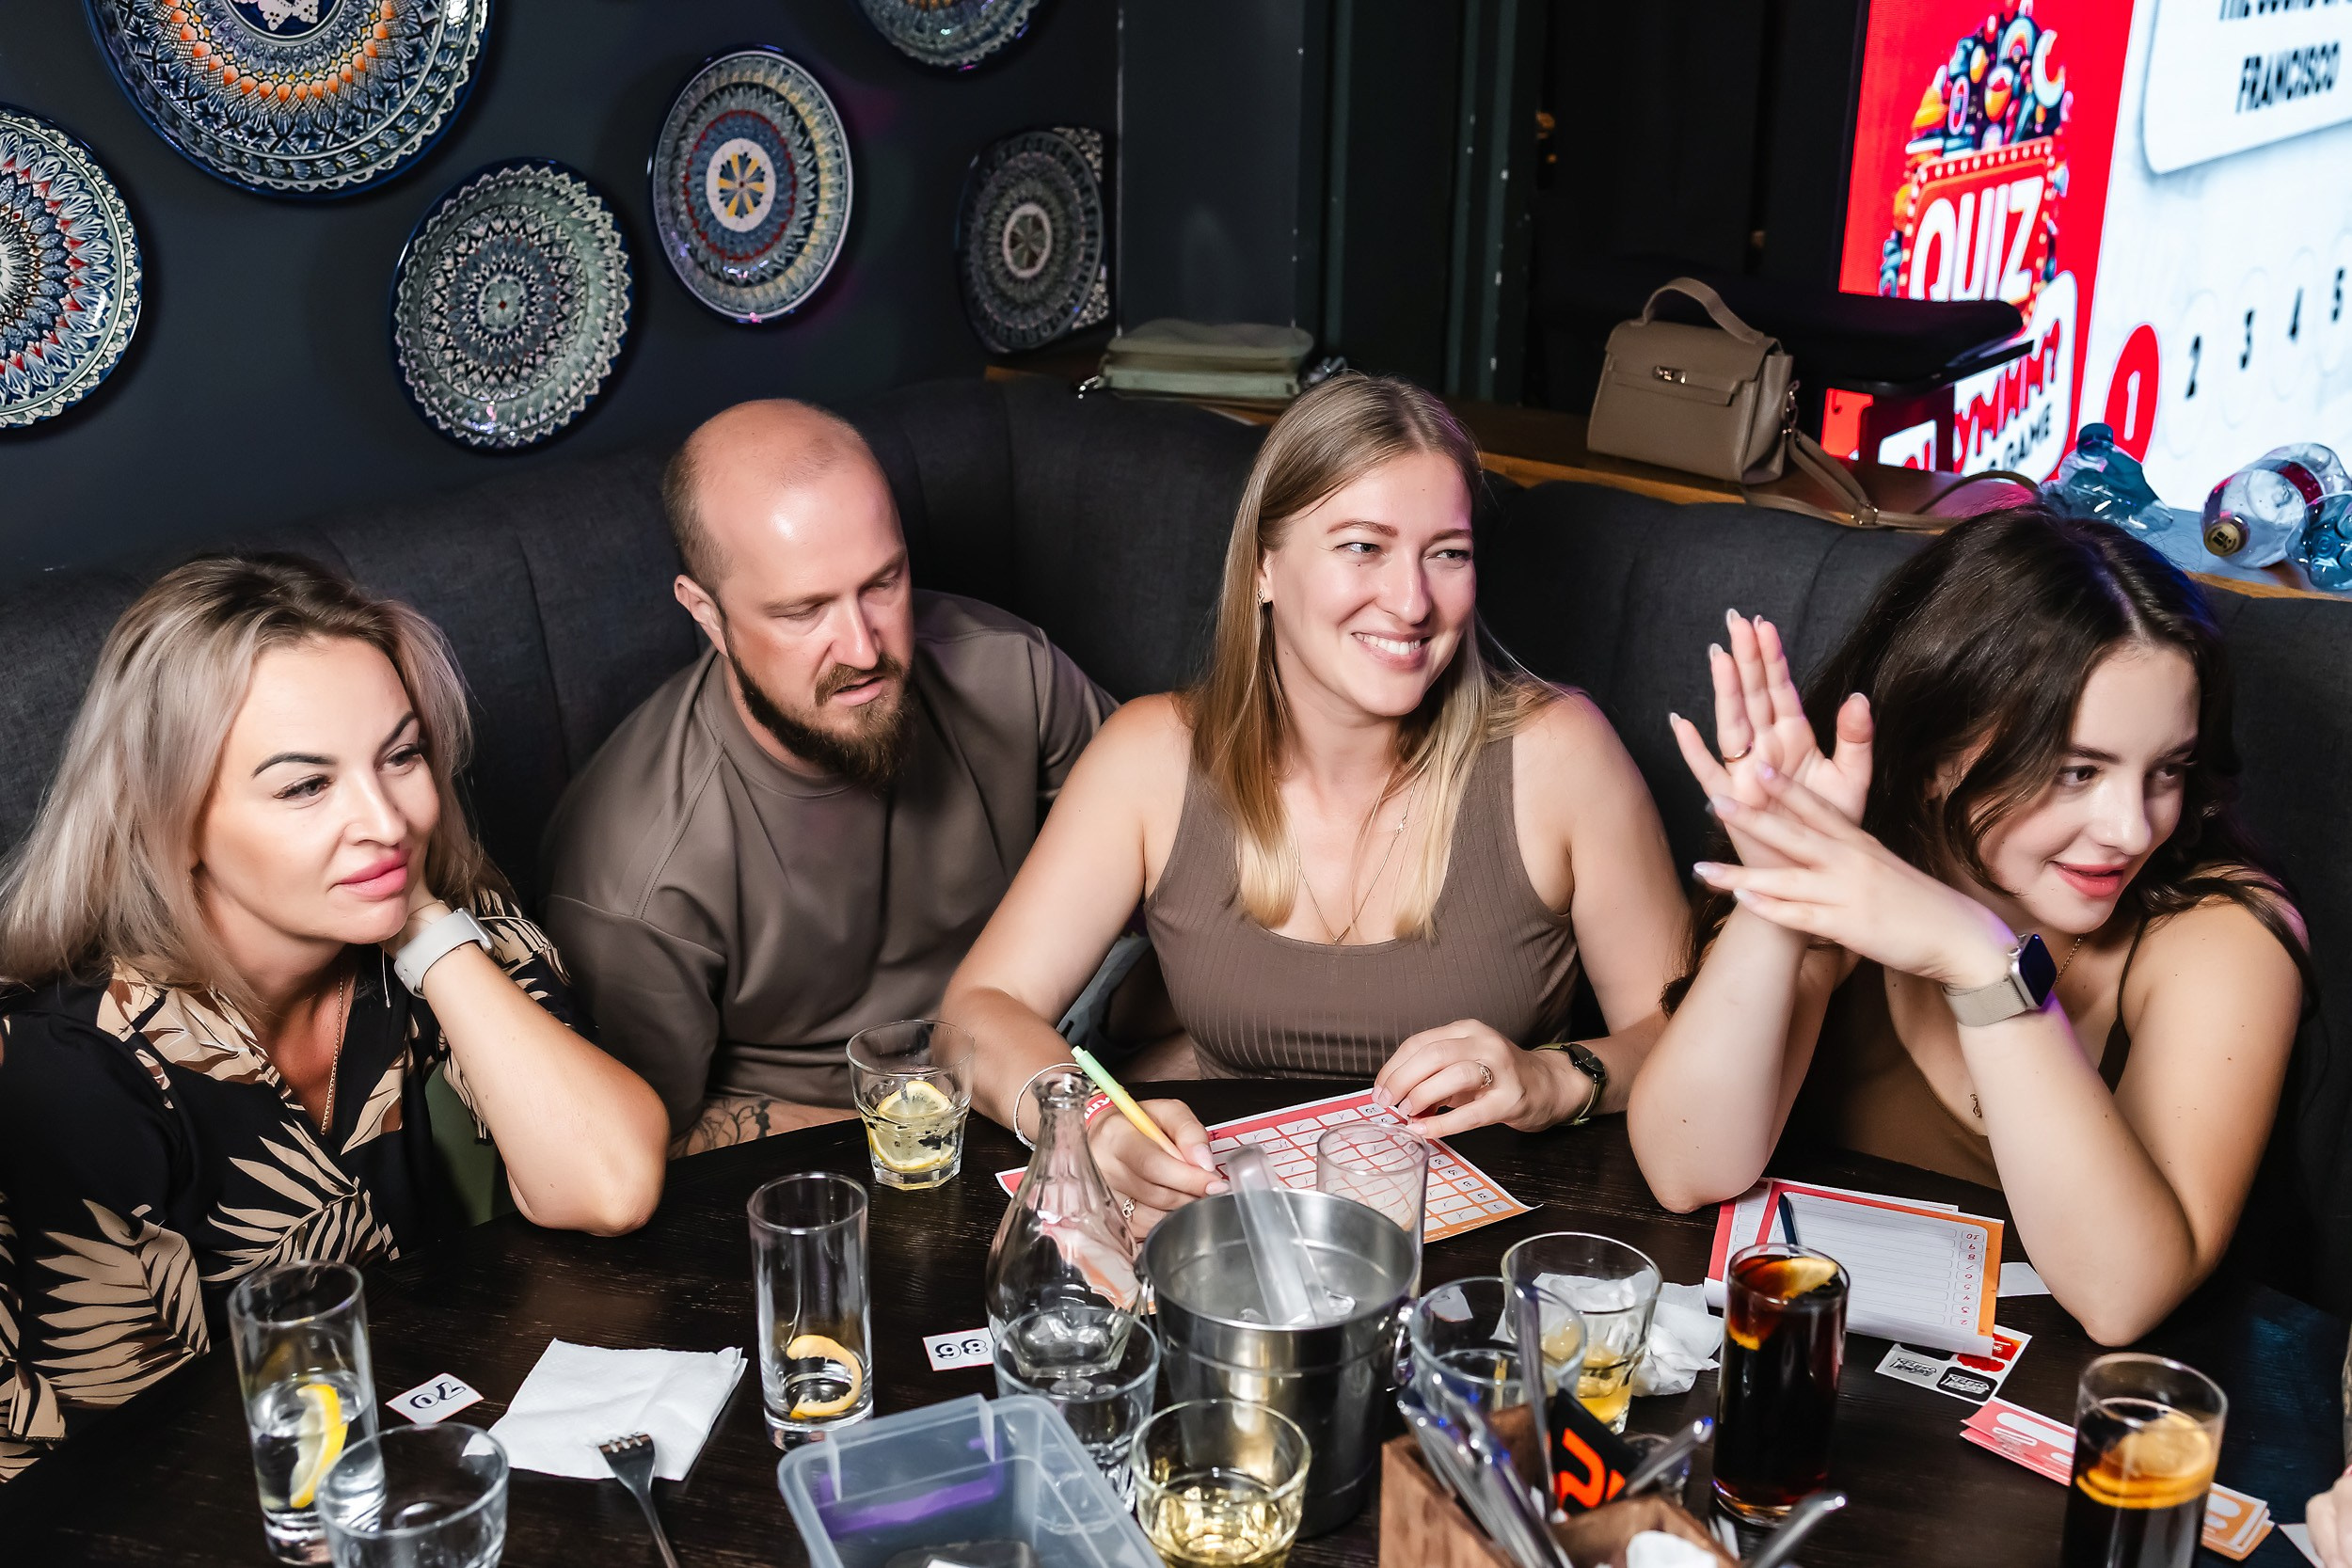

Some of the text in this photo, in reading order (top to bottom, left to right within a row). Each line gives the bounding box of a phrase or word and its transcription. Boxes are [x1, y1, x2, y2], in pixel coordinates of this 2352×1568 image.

[1908, 175, 2044, 301] QUIZ
[2123, 370, 2141, 441] 1
[2185, 334, 2202, 400] 2
[2239, 308, 2256, 370] 3
[2330, 267, 2346, 324] 5
[409, 1381, 467, 1409] 70
